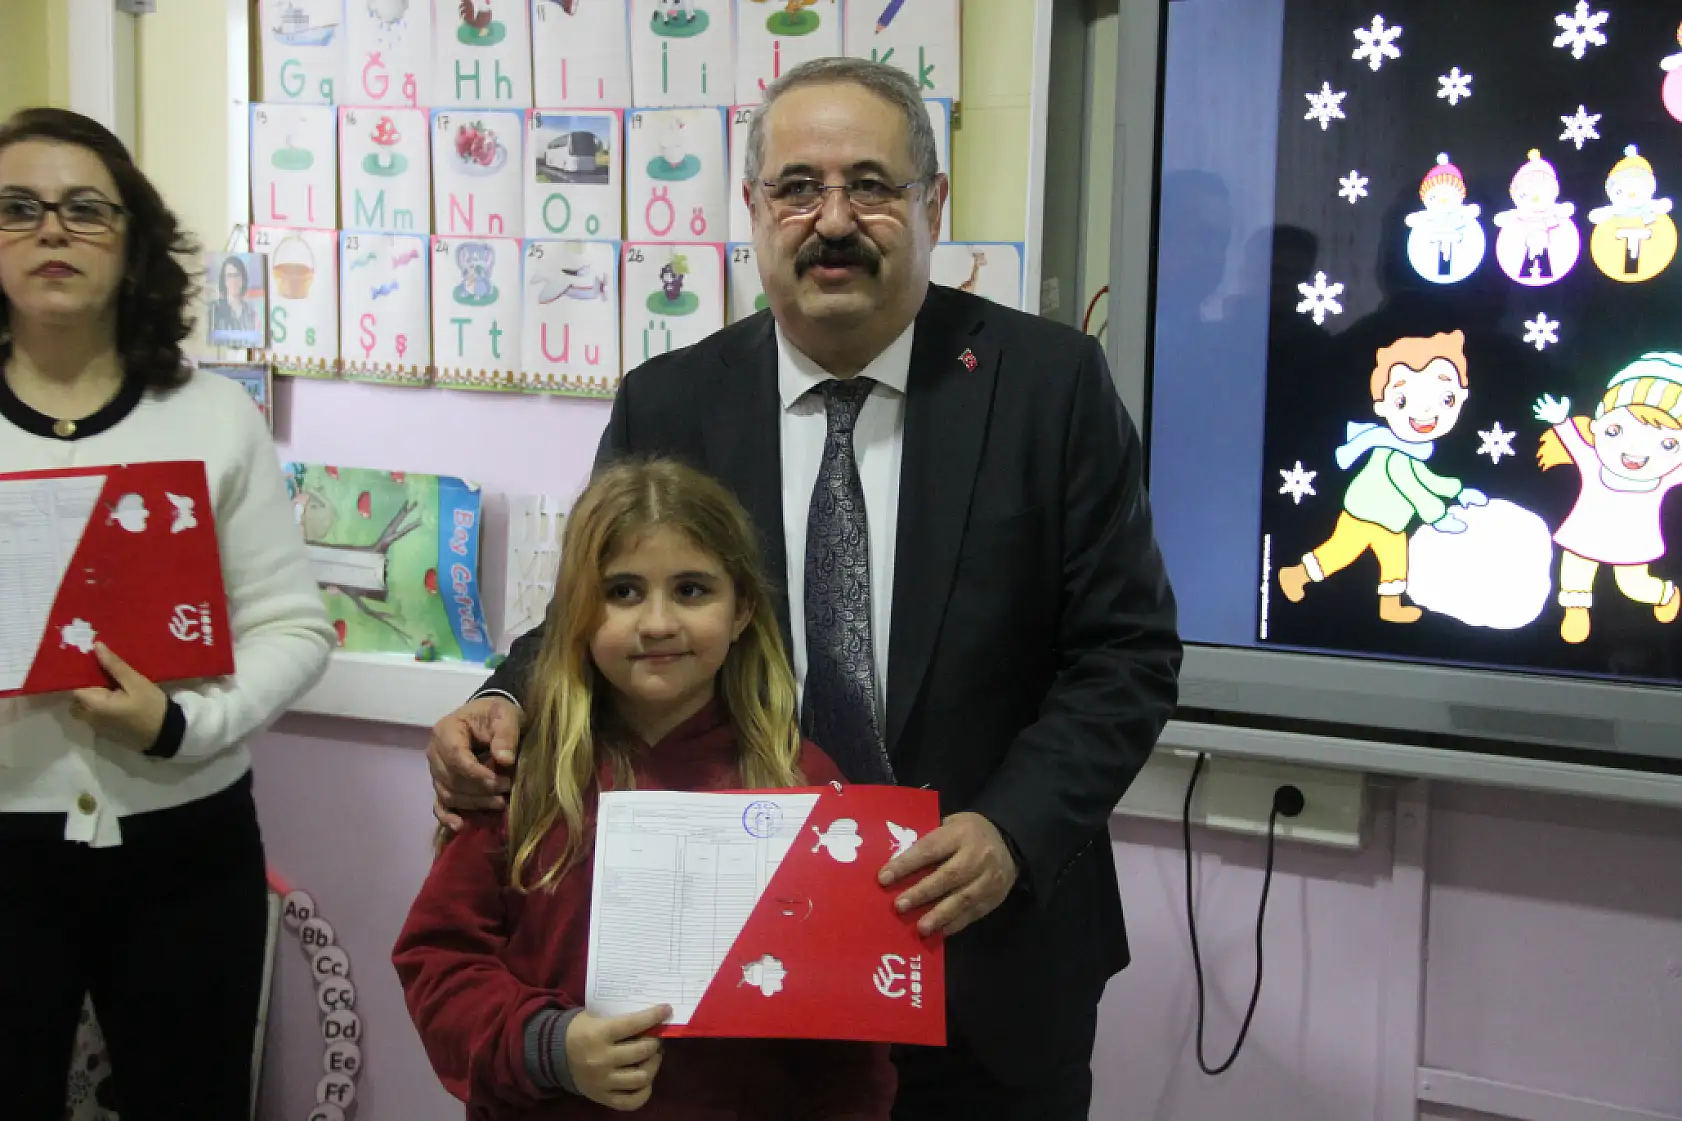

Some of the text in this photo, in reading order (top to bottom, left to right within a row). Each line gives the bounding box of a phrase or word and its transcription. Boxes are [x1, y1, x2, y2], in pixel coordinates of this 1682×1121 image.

[436, 240, 450, 256] 24
[628, 248, 645, 264] 26
[303, 927, 328, 948] Bb
[325, 1019, 357, 1039] Dd
